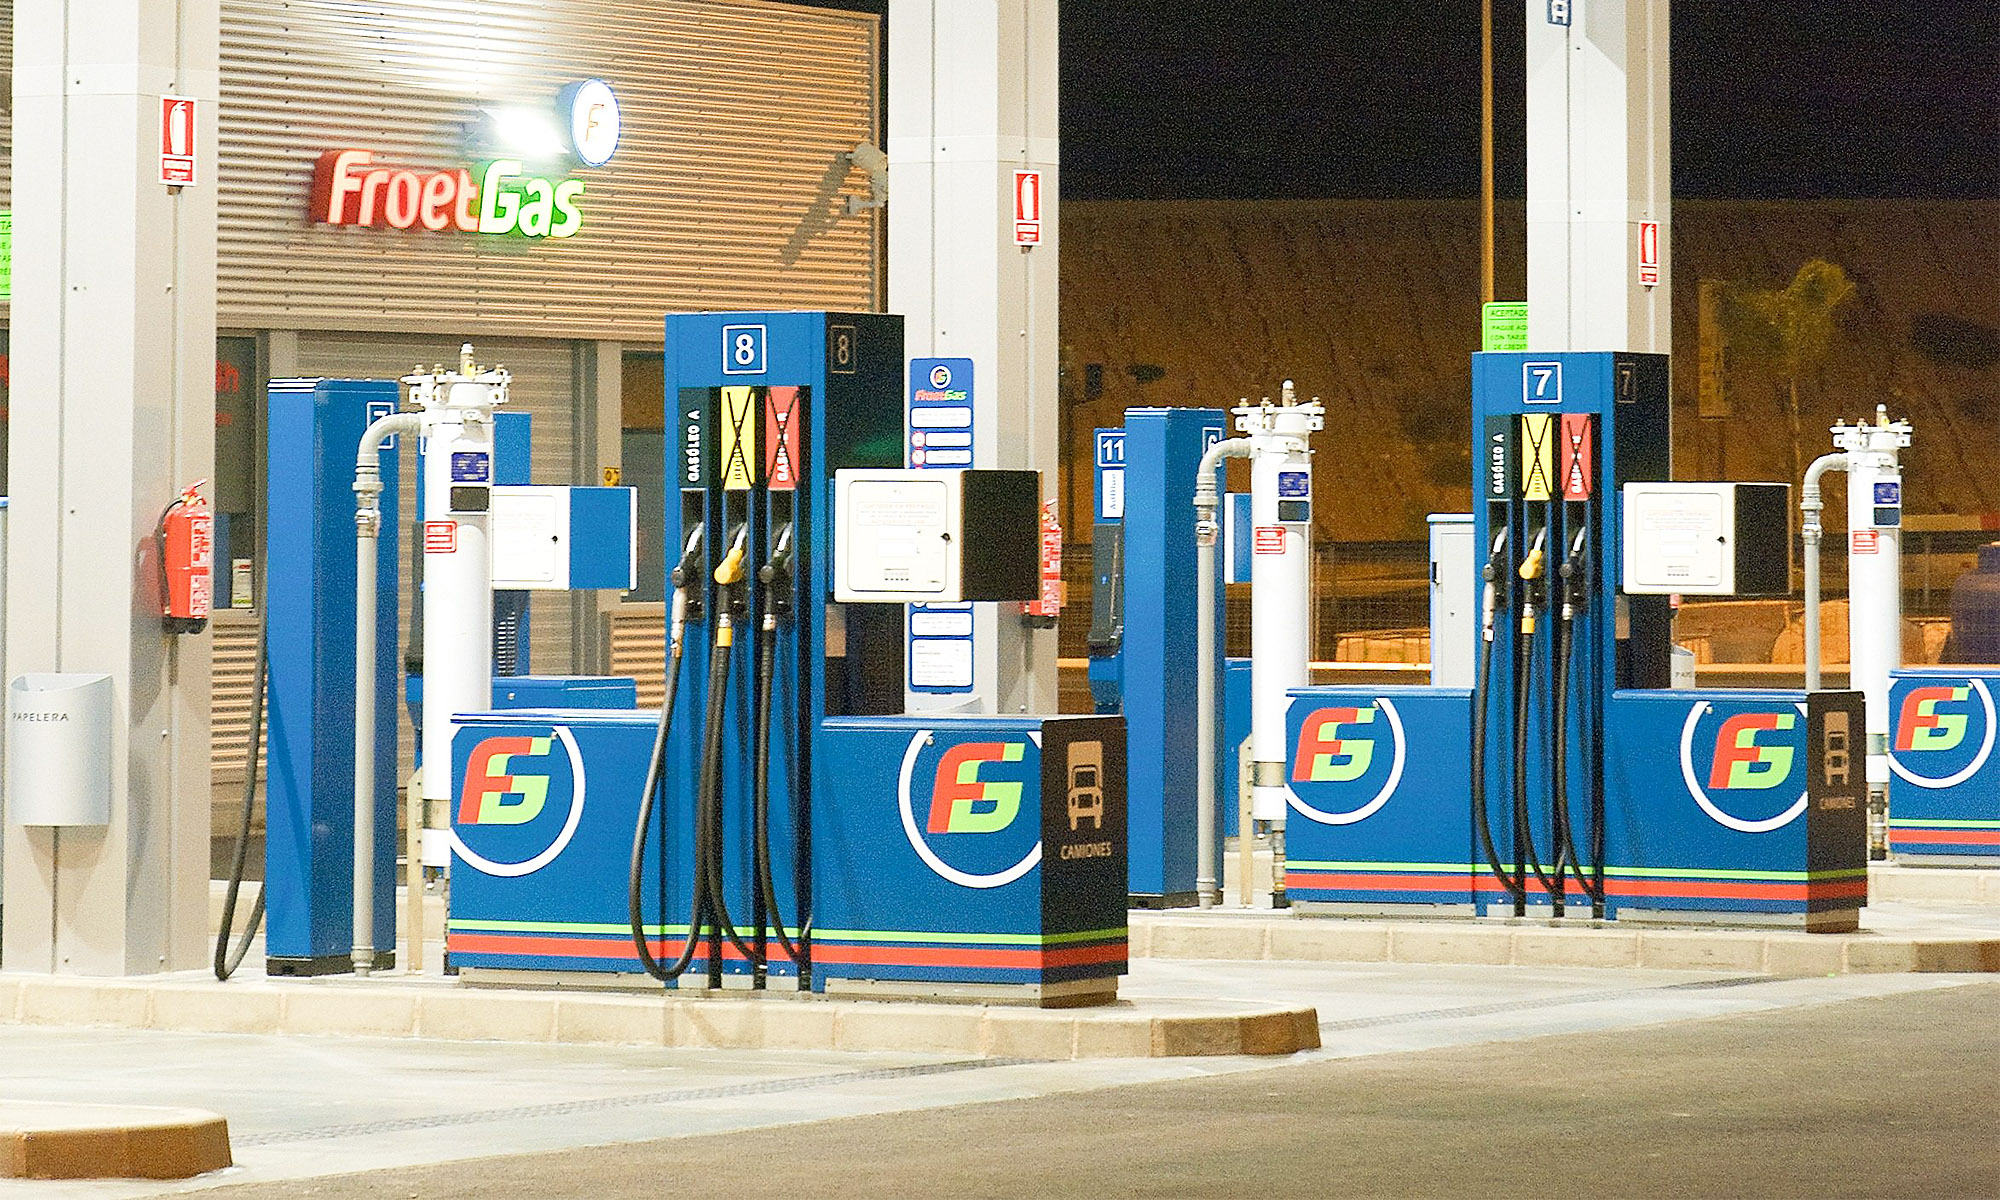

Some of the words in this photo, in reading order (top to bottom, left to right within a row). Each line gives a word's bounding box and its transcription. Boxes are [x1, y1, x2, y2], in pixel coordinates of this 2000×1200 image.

[326, 148, 586, 239] FroetGas
[735, 333, 755, 365] 8
[838, 335, 849, 364] 8
[1533, 369, 1553, 396] 7
[1621, 370, 1631, 396] 7
[687, 409, 700, 420] A
[686, 424, 700, 482] GASÓLEO
[1102, 438, 1124, 461] 11
[1491, 446, 1505, 494] GASÓLEO
[12, 712, 69, 721] PAPELERA
[1060, 842, 1112, 860] CAMIONES
